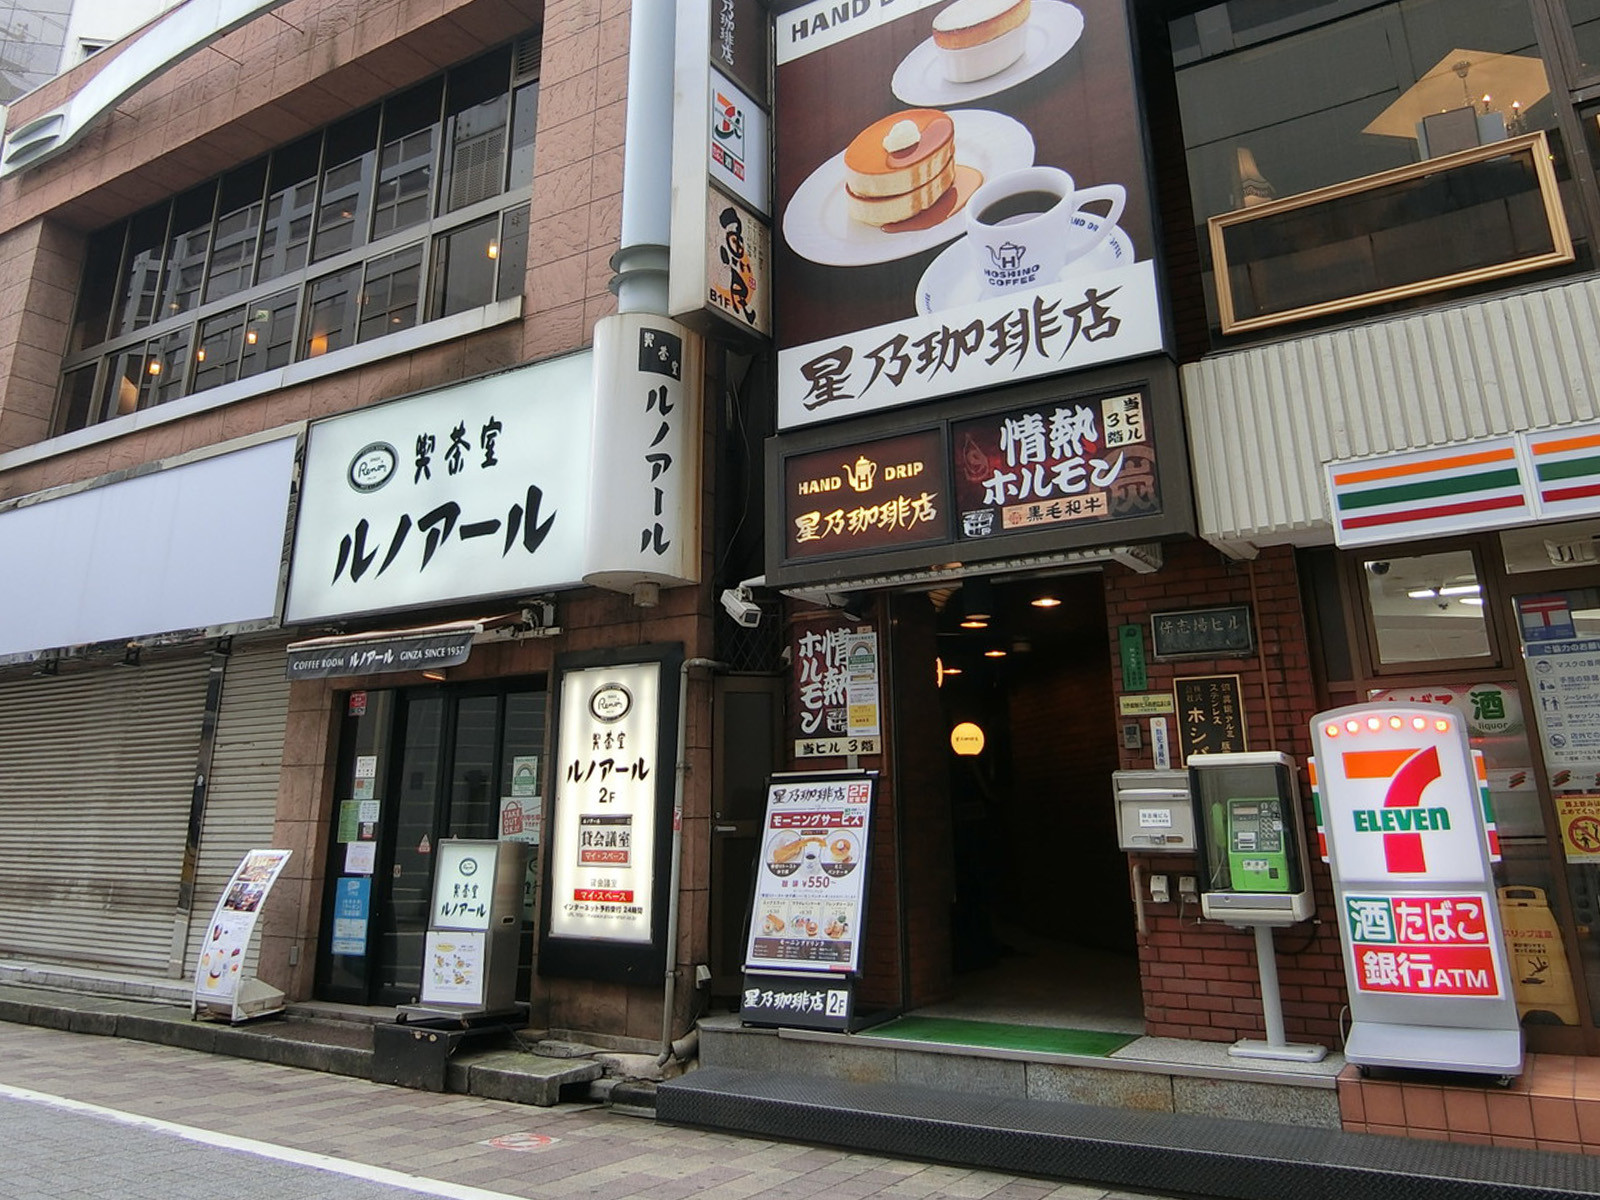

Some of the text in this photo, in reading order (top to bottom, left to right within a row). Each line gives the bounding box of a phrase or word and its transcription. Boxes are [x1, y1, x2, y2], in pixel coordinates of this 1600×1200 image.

[984, 264, 1040, 278] HOSHINO
[989, 274, 1035, 286] COFFEE
[710, 288, 731, 309] B1F
[801, 285, 1122, 411] 星乃珈琲店
[1000, 404, 1098, 467] 情熱
[413, 416, 502, 484] 喫茶室
[640, 384, 674, 556] ルノアール
[798, 476, 841, 495] HAND
[885, 462, 923, 481] DRIP
[983, 451, 1125, 505] ホルモン
[795, 492, 938, 543] 星乃珈琲店
[1027, 497, 1103, 522] 黒毛和牛
[331, 484, 557, 586] ルノアール
[293, 660, 320, 670] COFFEE
[321, 657, 345, 668] ROOM
[400, 650, 423, 660] GINZA
[424, 647, 446, 658] SINCE
[799, 630, 823, 734] ホルモン
[1209, 683, 1223, 725] ステンレス
[1470, 690, 1505, 720] 酒
[1479, 722, 1508, 731] liquor
[567, 757, 650, 783] ルノアール
[599, 787, 616, 803] 2F
[773, 786, 846, 804] 星乃珈琲店
[772, 814, 860, 826] モーニングサービス
[581, 830, 630, 848] 貸会議室
[440, 901, 488, 918] ルノアール
[1349, 900, 1485, 942] 酒 たばこ
[744, 988, 845, 1014] 星乃珈琲店 2F
